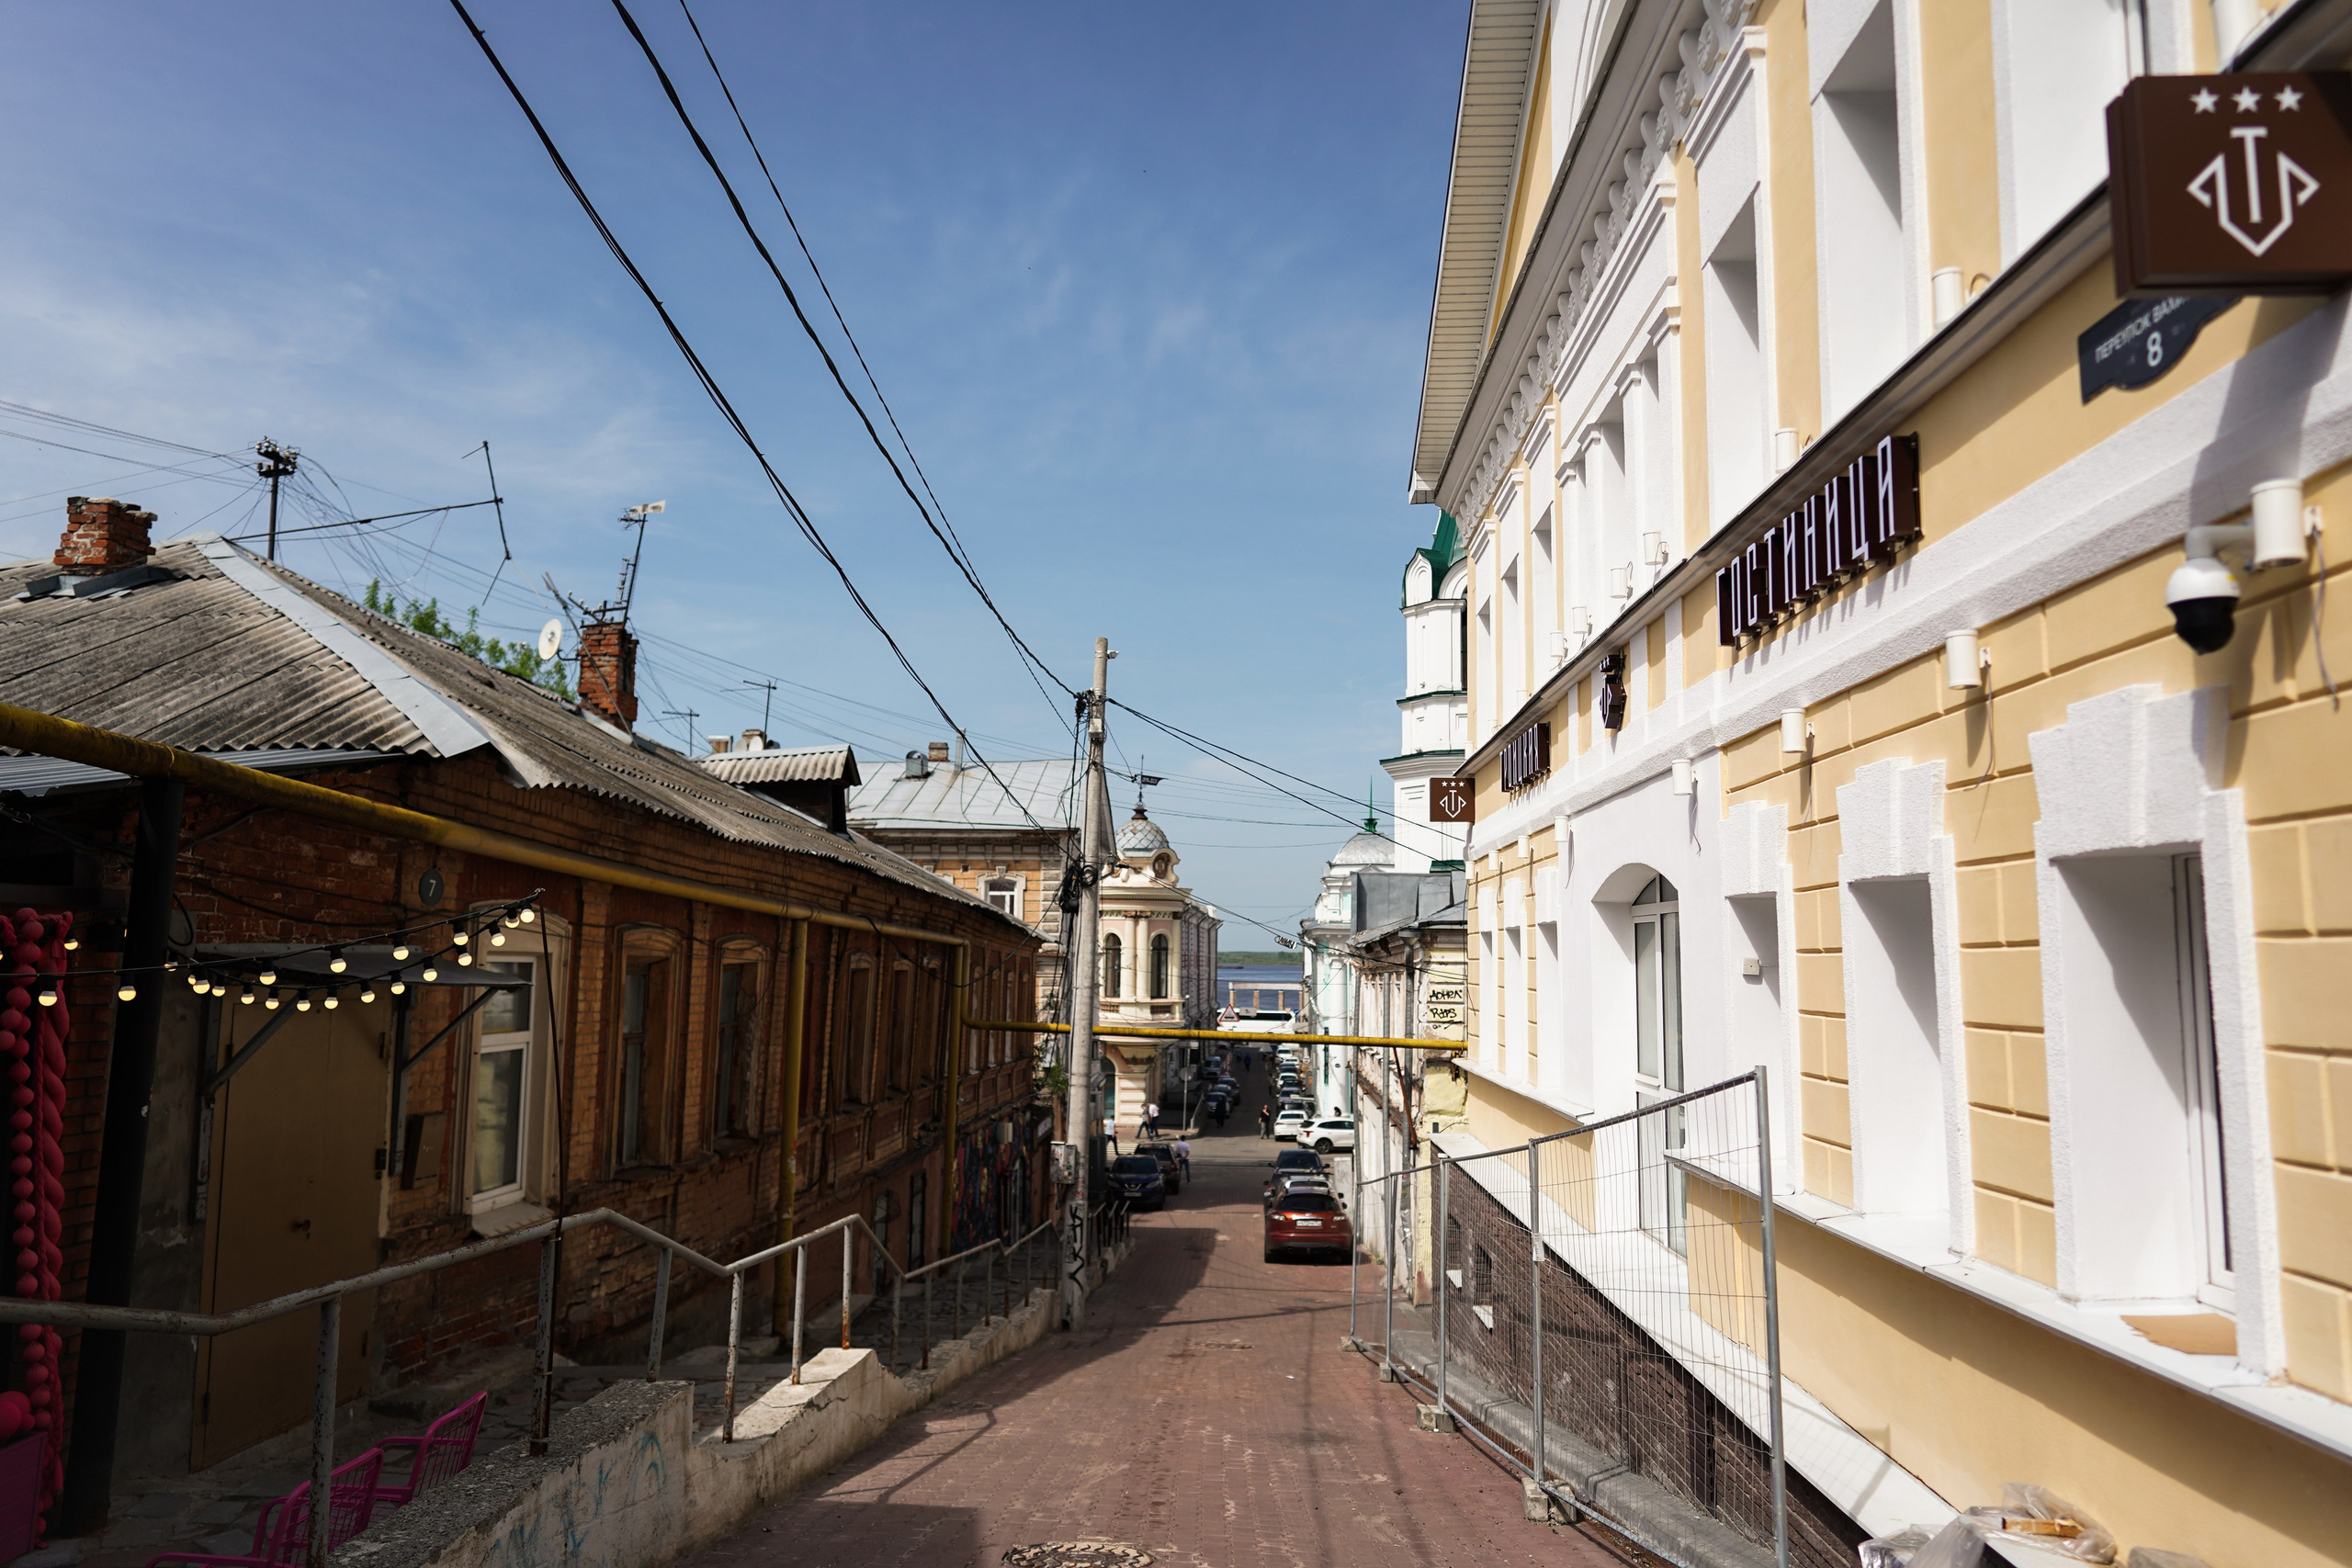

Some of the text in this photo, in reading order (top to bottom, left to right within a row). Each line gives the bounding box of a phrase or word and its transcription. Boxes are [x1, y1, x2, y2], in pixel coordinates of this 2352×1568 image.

[2147, 331, 2164, 367] 8
[1715, 435, 1895, 647] ГОСТИНИЦА
[428, 879, 436, 897] 7
